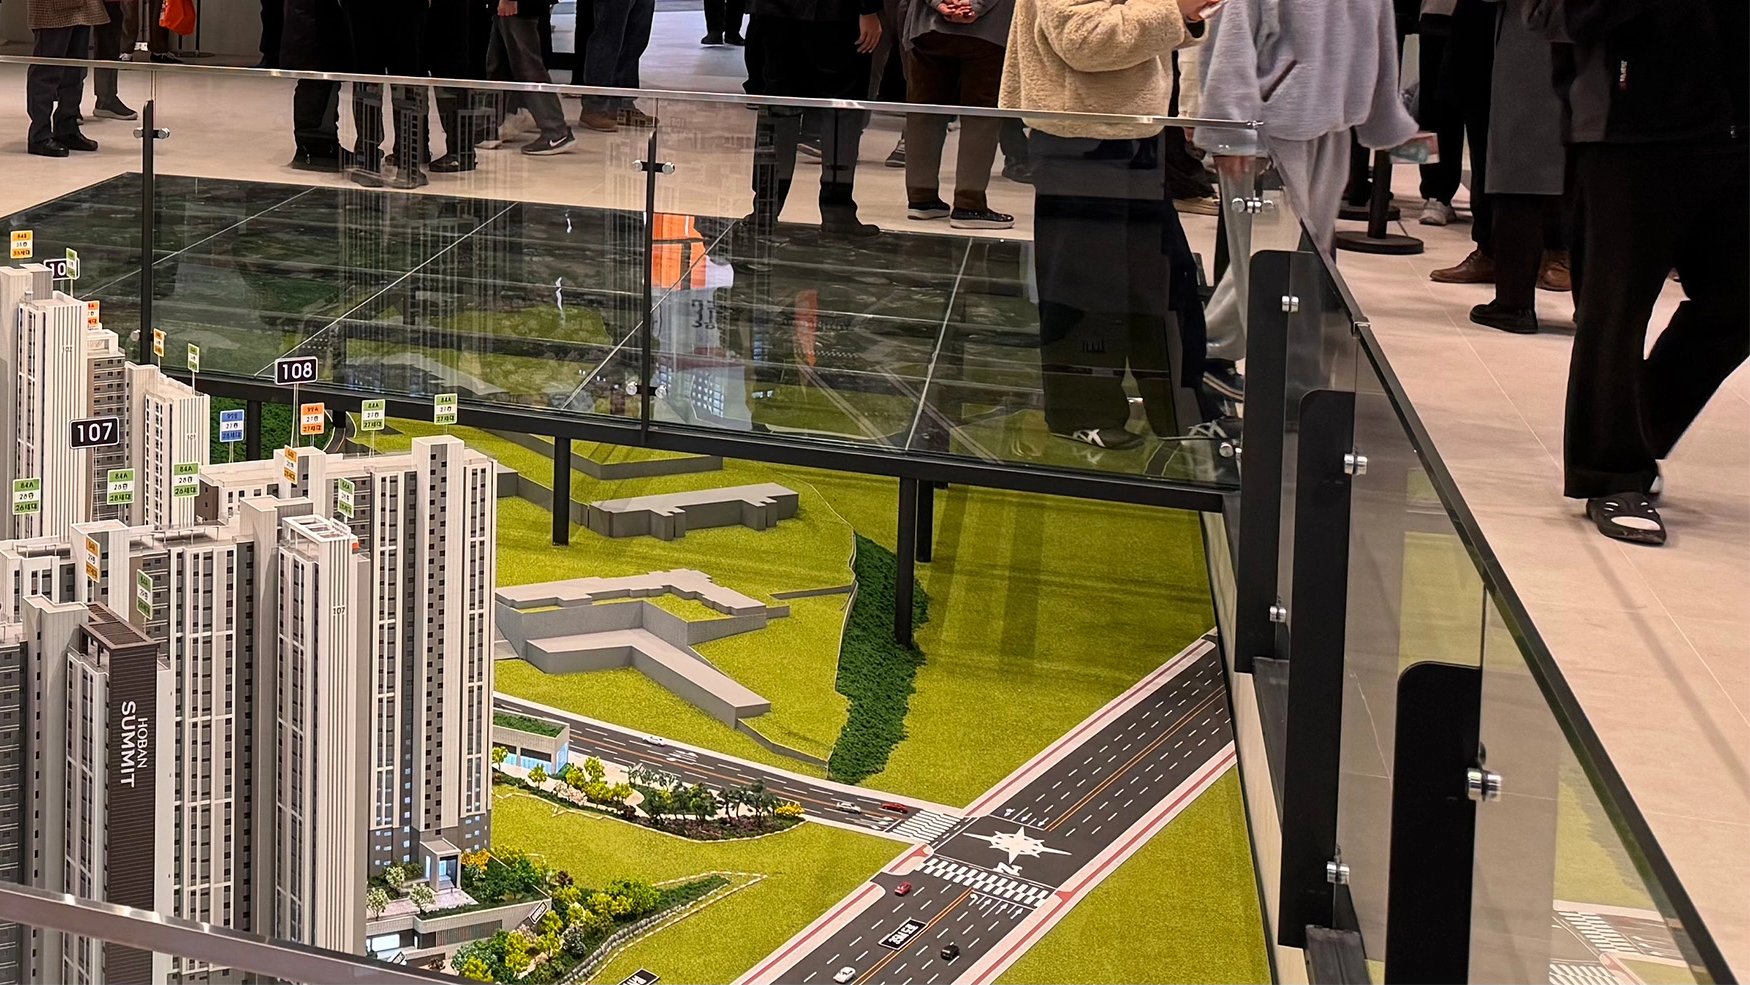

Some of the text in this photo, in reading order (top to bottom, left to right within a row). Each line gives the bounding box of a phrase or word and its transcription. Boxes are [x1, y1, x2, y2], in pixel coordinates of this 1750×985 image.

[281, 363, 313, 379] 108
[77, 422, 114, 443] 107
[120, 700, 136, 789] SUMMIT
[137, 716, 148, 769] HOBAN
